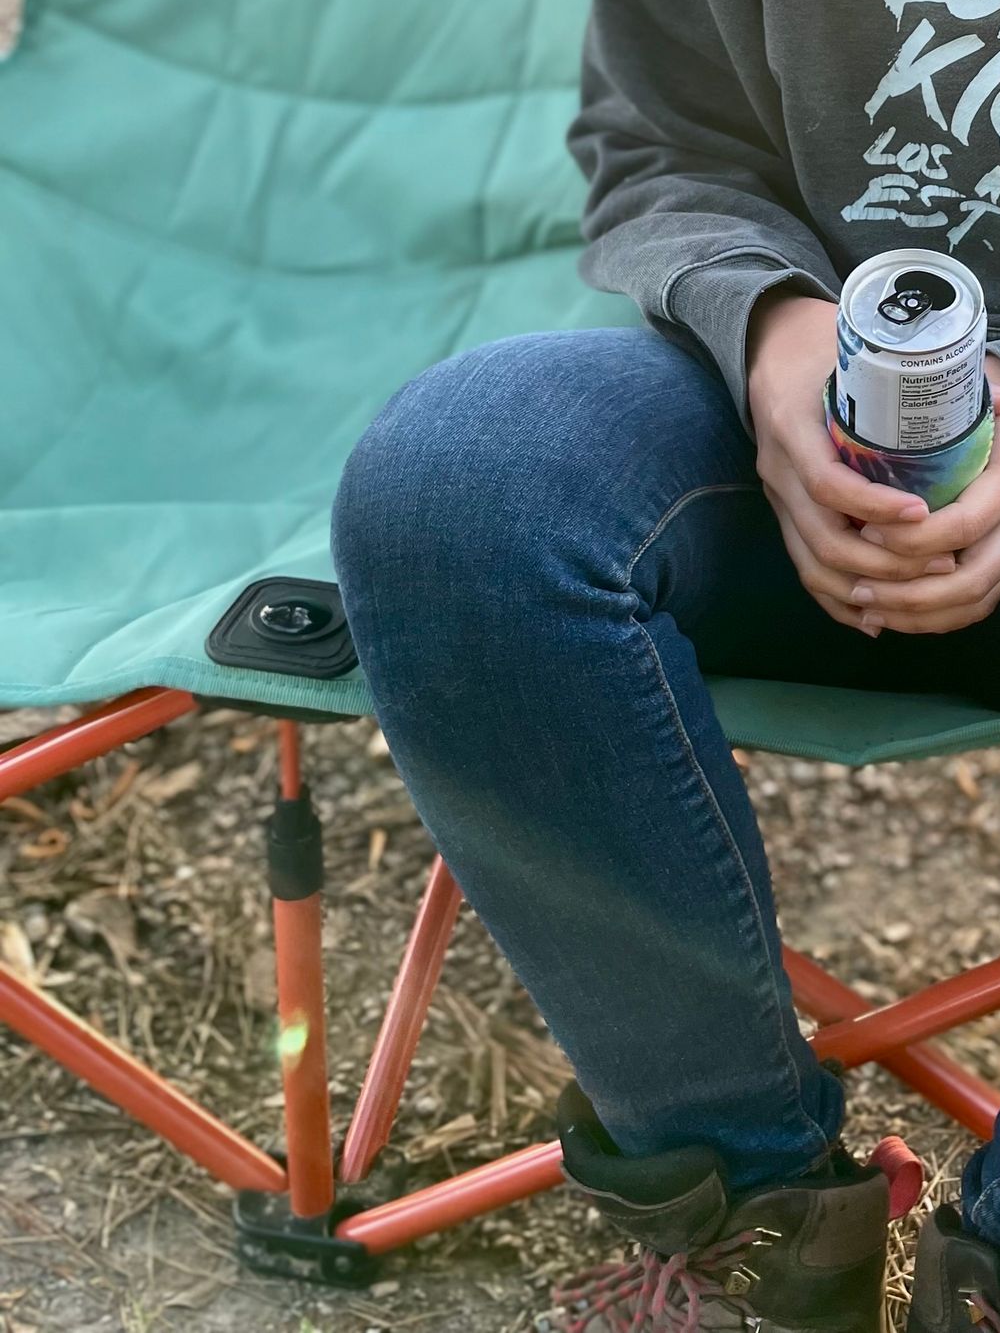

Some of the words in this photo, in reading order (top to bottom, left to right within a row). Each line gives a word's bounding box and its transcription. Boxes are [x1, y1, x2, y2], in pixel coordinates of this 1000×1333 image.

[863, 126, 952, 180] LOS
[901, 356, 943, 368] CONTAINS
[945, 337, 975, 361] ALCOHOL
[902, 374, 944, 384] Nutrition
[946, 362, 968, 377] Facts
[901, 399, 938, 408] Calories
